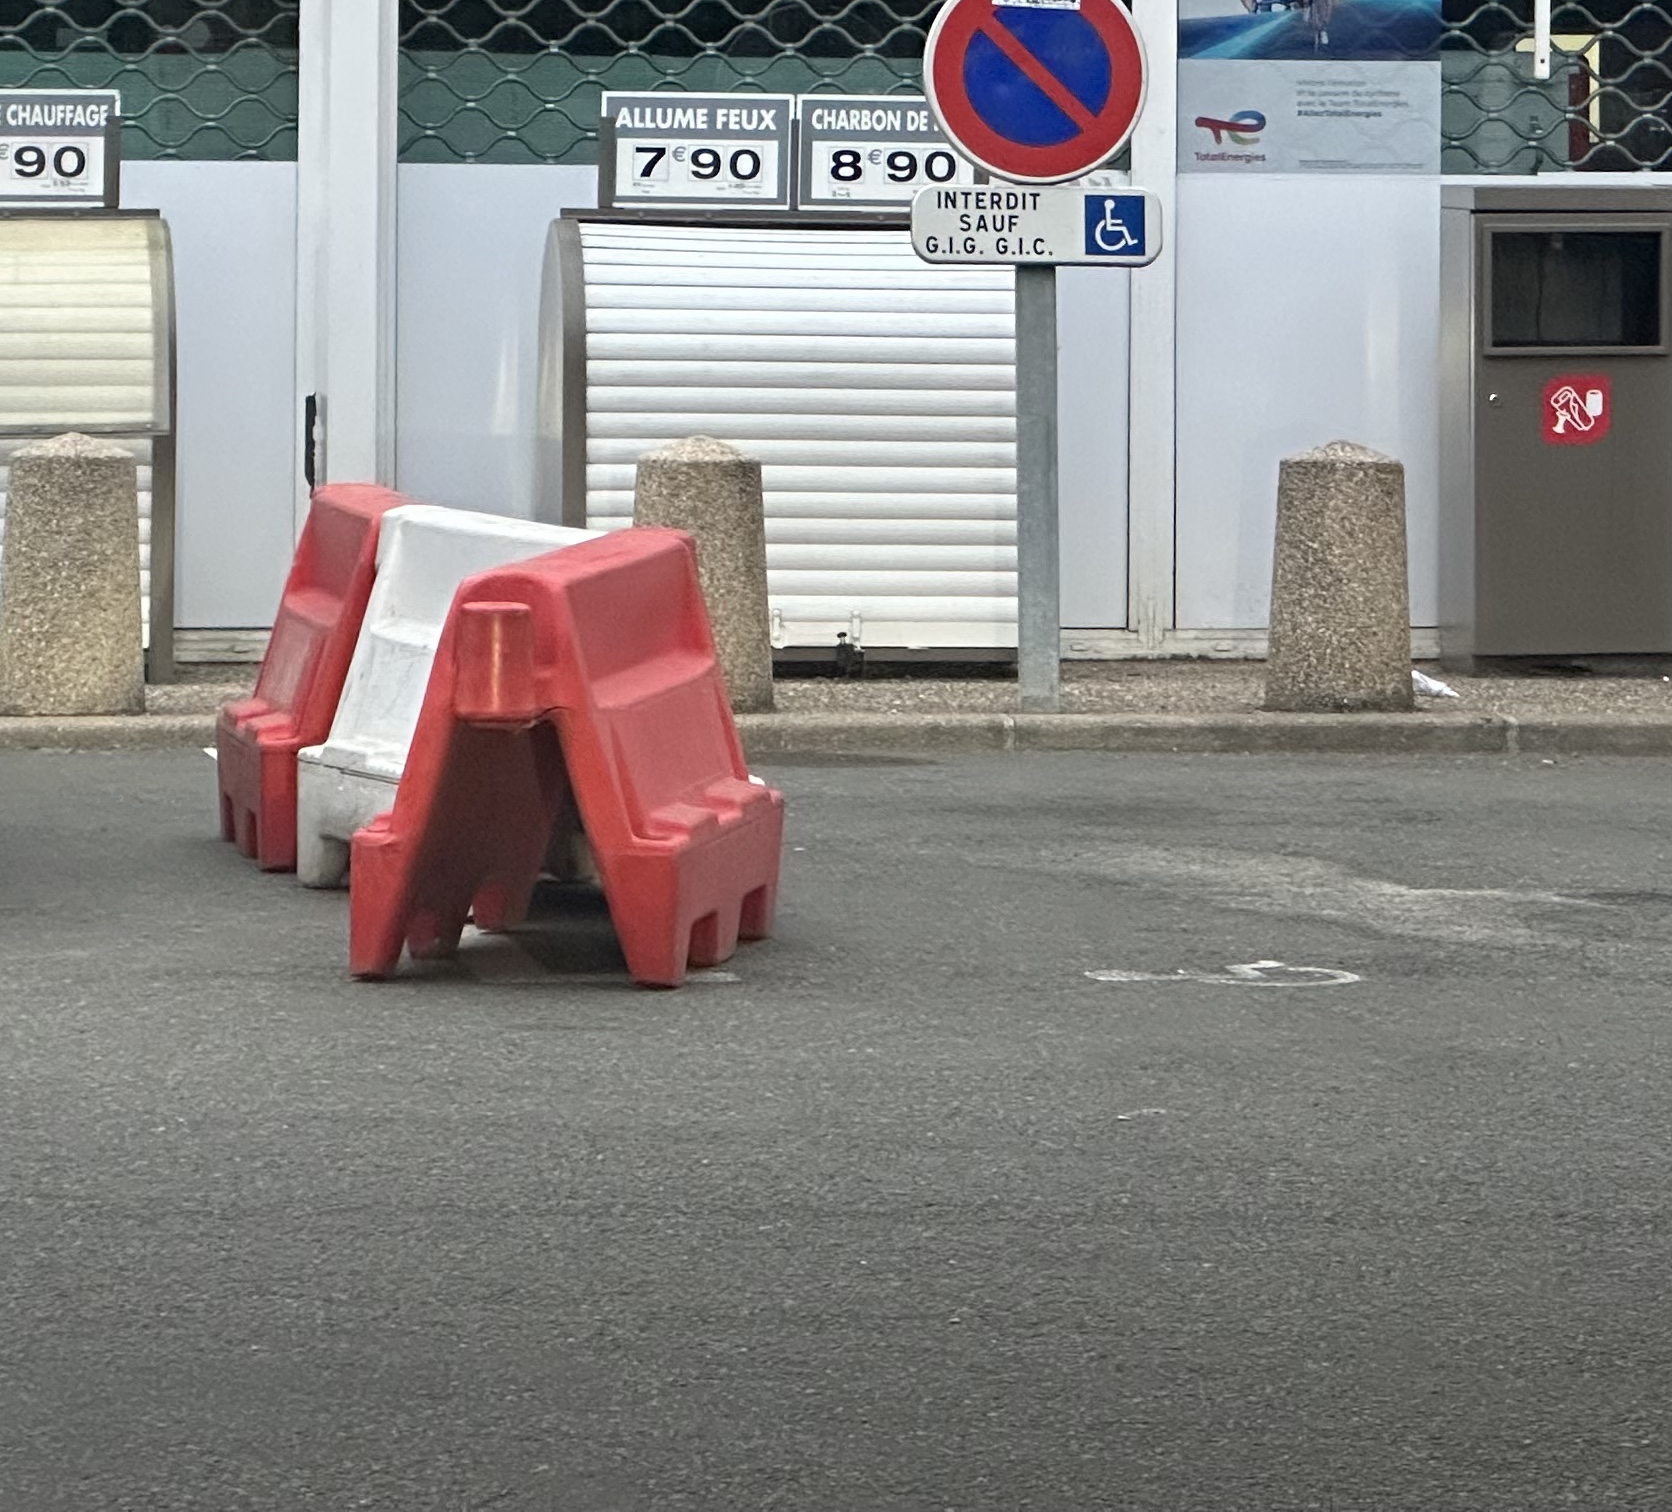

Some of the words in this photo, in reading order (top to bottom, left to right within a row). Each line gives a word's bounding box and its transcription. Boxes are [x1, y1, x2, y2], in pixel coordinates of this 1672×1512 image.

[5, 103, 109, 127] CHAUFFAGE
[615, 107, 713, 130] ALLUME
[716, 108, 778, 130] FEUX
[811, 109, 902, 131] CHARBON
[906, 111, 930, 131] DE
[1194, 151, 1267, 164] TotalEnergies
[936, 191, 1041, 211] INTERDIT
[959, 213, 1020, 233] SAUF
[926, 236, 984, 255] G.I.G.
[996, 237, 1054, 256] G.I.C.
